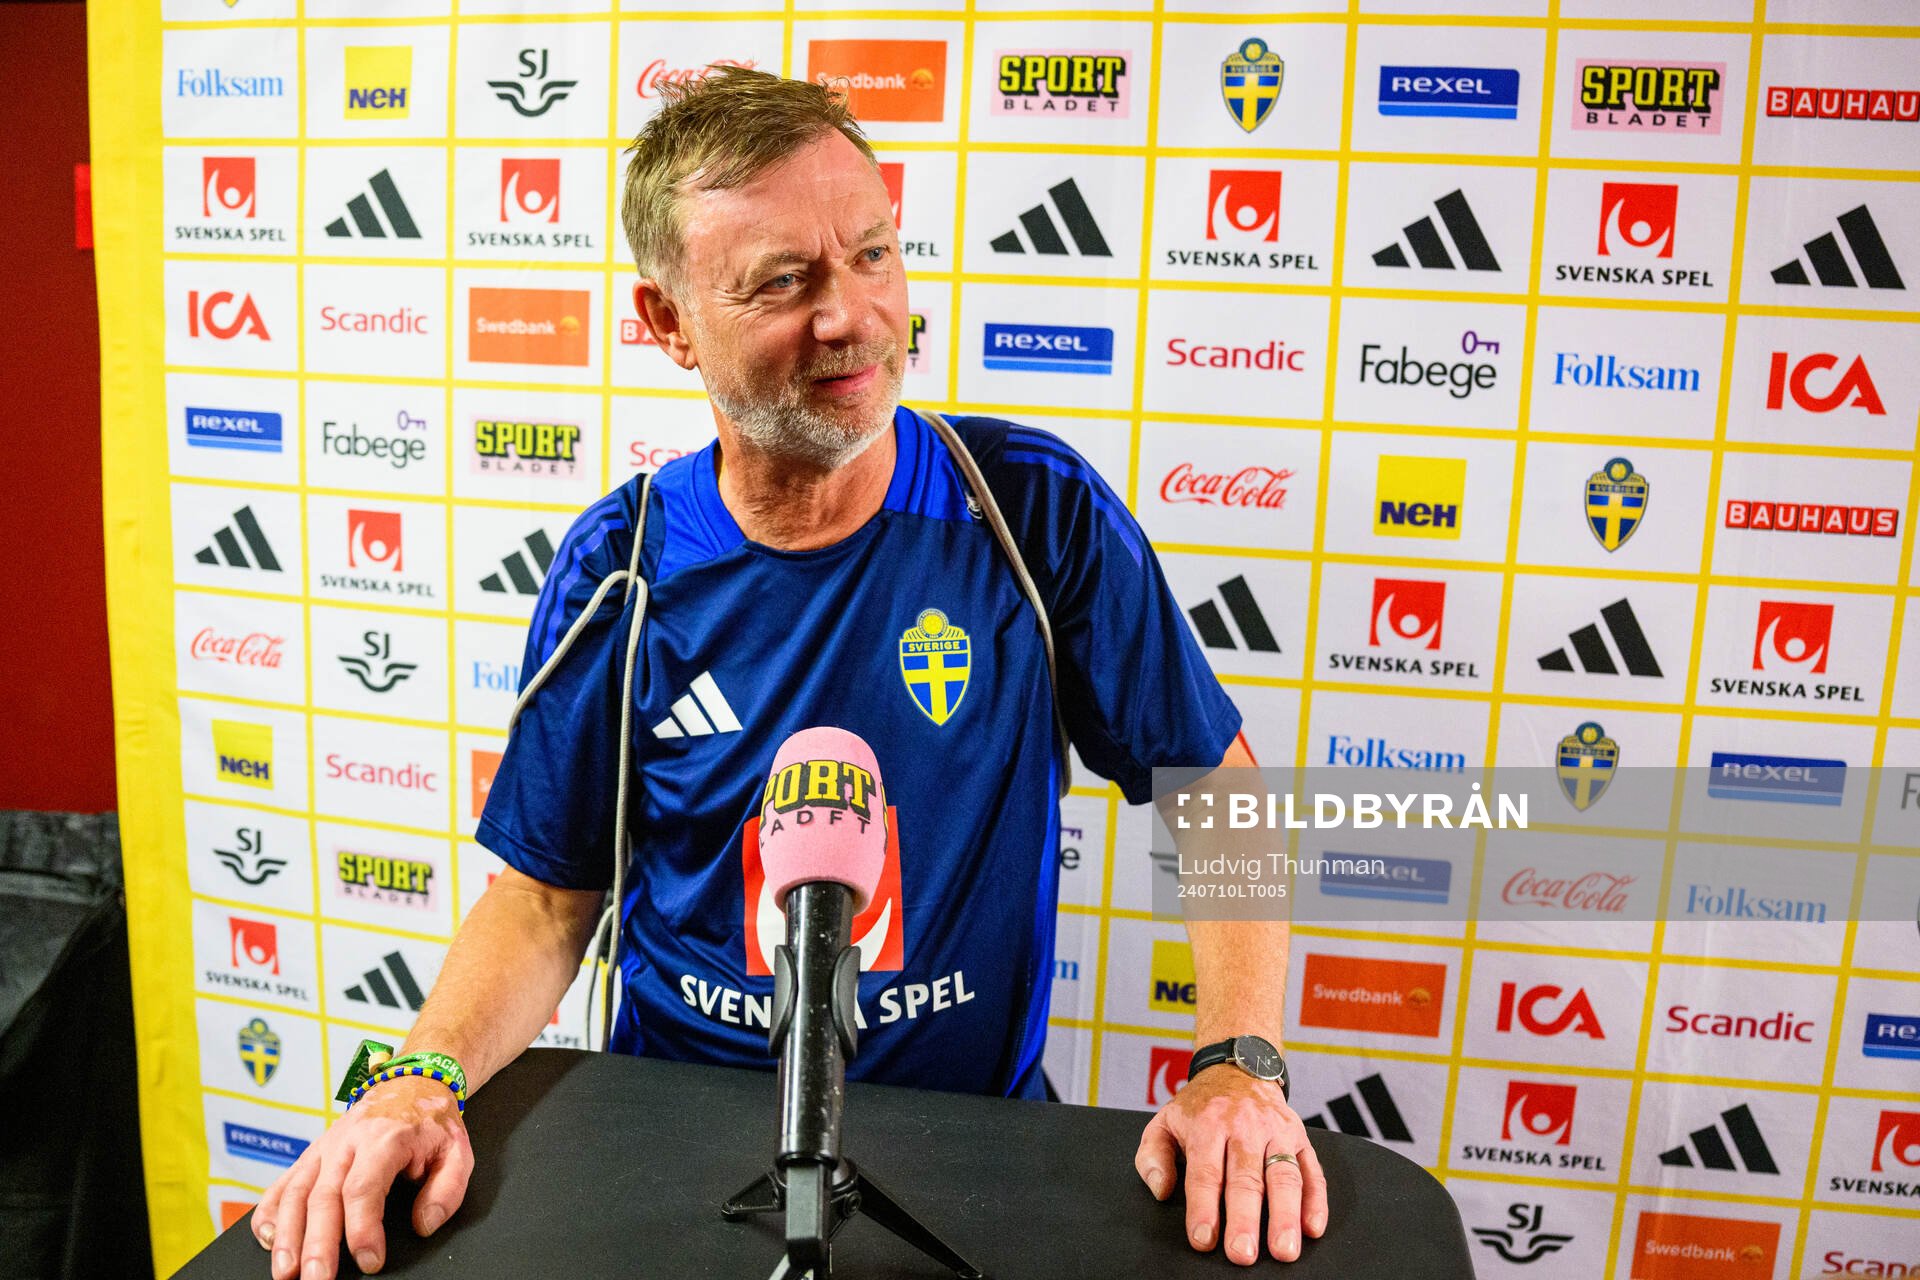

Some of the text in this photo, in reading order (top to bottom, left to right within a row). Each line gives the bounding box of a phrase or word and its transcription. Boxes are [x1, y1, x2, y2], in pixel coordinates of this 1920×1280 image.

[518, 48, 549, 79] SJ
[998, 55, 1127, 99] SPORT
[177, 68, 284, 97] Folksam
[816, 72, 906, 90] Swedbank
[1580, 64, 1721, 114] SPORT
[1003, 98, 1121, 113] BLADET
[1770, 90, 1918, 118] BAUHAU
[1586, 111, 1711, 129] BLADET
[175, 225, 287, 242] SVENSKA SPEL
[468, 231, 594, 249] SVENSKA SPEL
[1166, 249, 1319, 271] SVENSKA SPEL
[1555, 264, 1714, 288] SVENSKA SPEL
[187, 290, 272, 341] ICA
[320, 305, 429, 335] Scandic
[476, 317, 556, 336] Swedbank
[1166, 337, 1306, 373] Scandic
[1359, 344, 1497, 399] Fabege
[1552, 352, 1701, 393] Folksam
[1766, 351, 1888, 416] ICA
[322, 421, 428, 469] Fabege
[475, 419, 581, 462] SPORT
[480, 459, 577, 475] BLADET
[1159, 462, 1298, 510] Coca-Cola
[1728, 503, 1895, 533] BAUHAUS
[320, 573, 435, 598] SVENSKA SPEL
[363, 630, 391, 660] SJ
[908, 641, 961, 652] SVERIGE
[1328, 653, 1480, 678] SVENSKA SPEL
[1710, 677, 1865, 703] SVENSKA SPEL
[1326, 734, 1467, 775] Folksam
[325, 753, 439, 793] Scandic
[760, 759, 877, 832] PORT
[236, 827, 263, 856] SJ
[337, 851, 433, 895] SPORT
[1502, 866, 1640, 914] Coca-Cola
[1685, 884, 1828, 924] Folksam
[205, 970, 310, 1002] SVENSKA SPEL
[879, 970, 976, 1024] SPEL
[1154, 981, 1197, 1005] Ne
[1312, 983, 1405, 1007] Swedbank
[1496, 981, 1606, 1041] ICA
[1665, 1004, 1816, 1043] Scandic
[1462, 1144, 1607, 1172] SVENSKA SPEL
[1507, 1203, 1544, 1233] SJ
[1645, 1239, 1736, 1263] Swedbank
[1822, 1250, 1920, 1278] Scan
